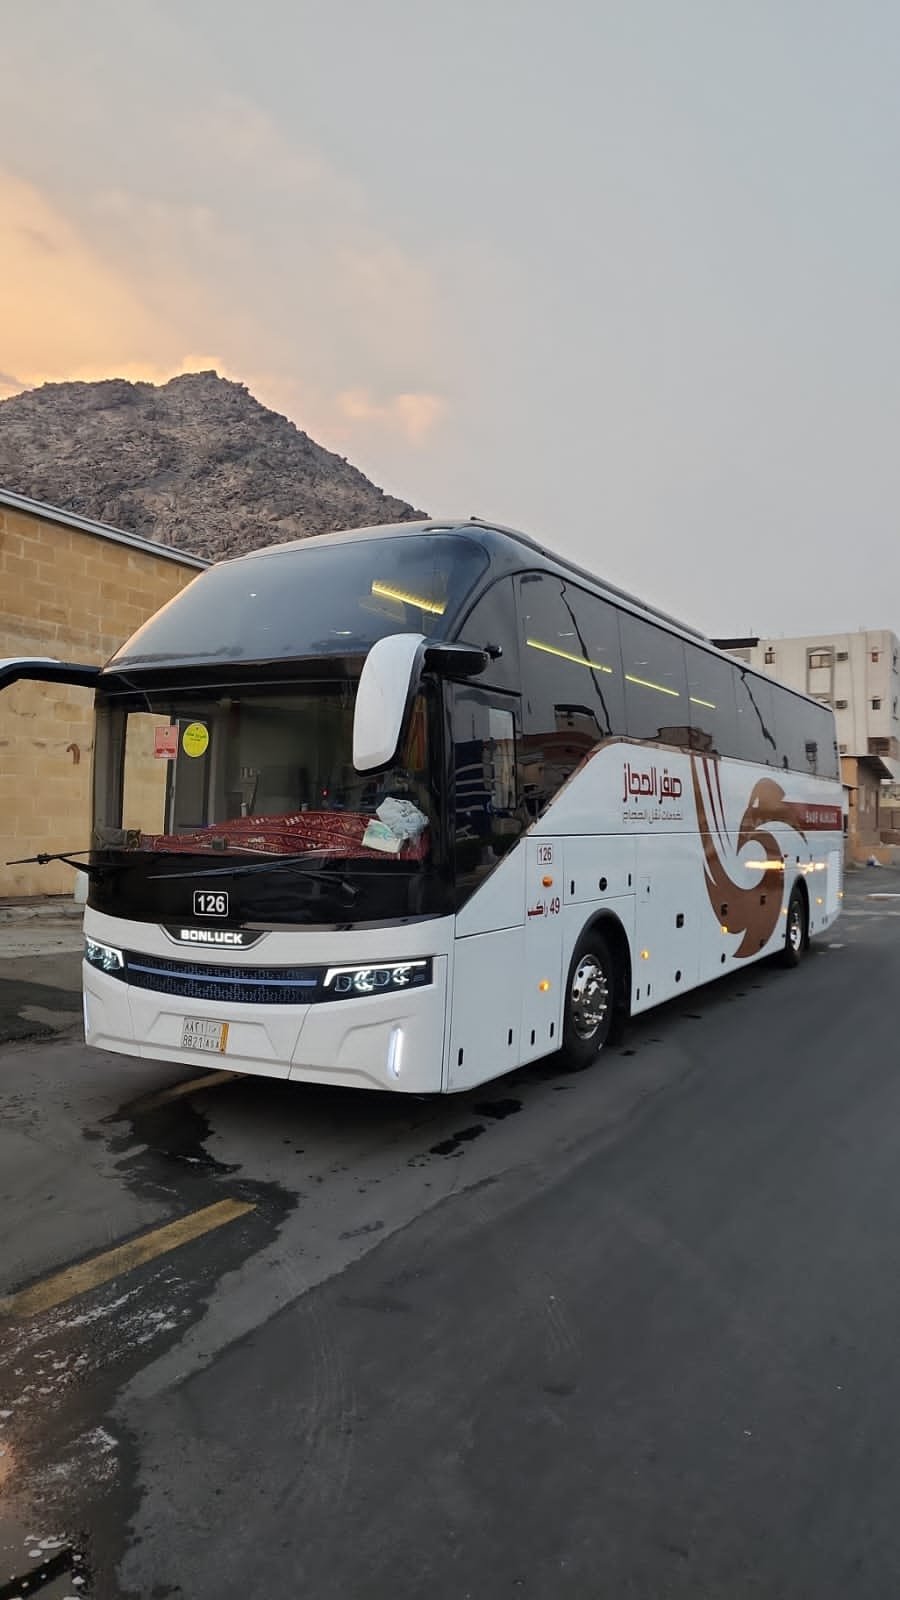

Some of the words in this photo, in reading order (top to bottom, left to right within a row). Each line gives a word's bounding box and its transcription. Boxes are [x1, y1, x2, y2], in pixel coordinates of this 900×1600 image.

[623, 763, 657, 803] الحجاز
[658, 768, 682, 804] صقر
[539, 847, 552, 861] 126
[198, 895, 225, 912] 126
[549, 897, 560, 914] 49
[181, 929, 243, 944] BONLUCK
